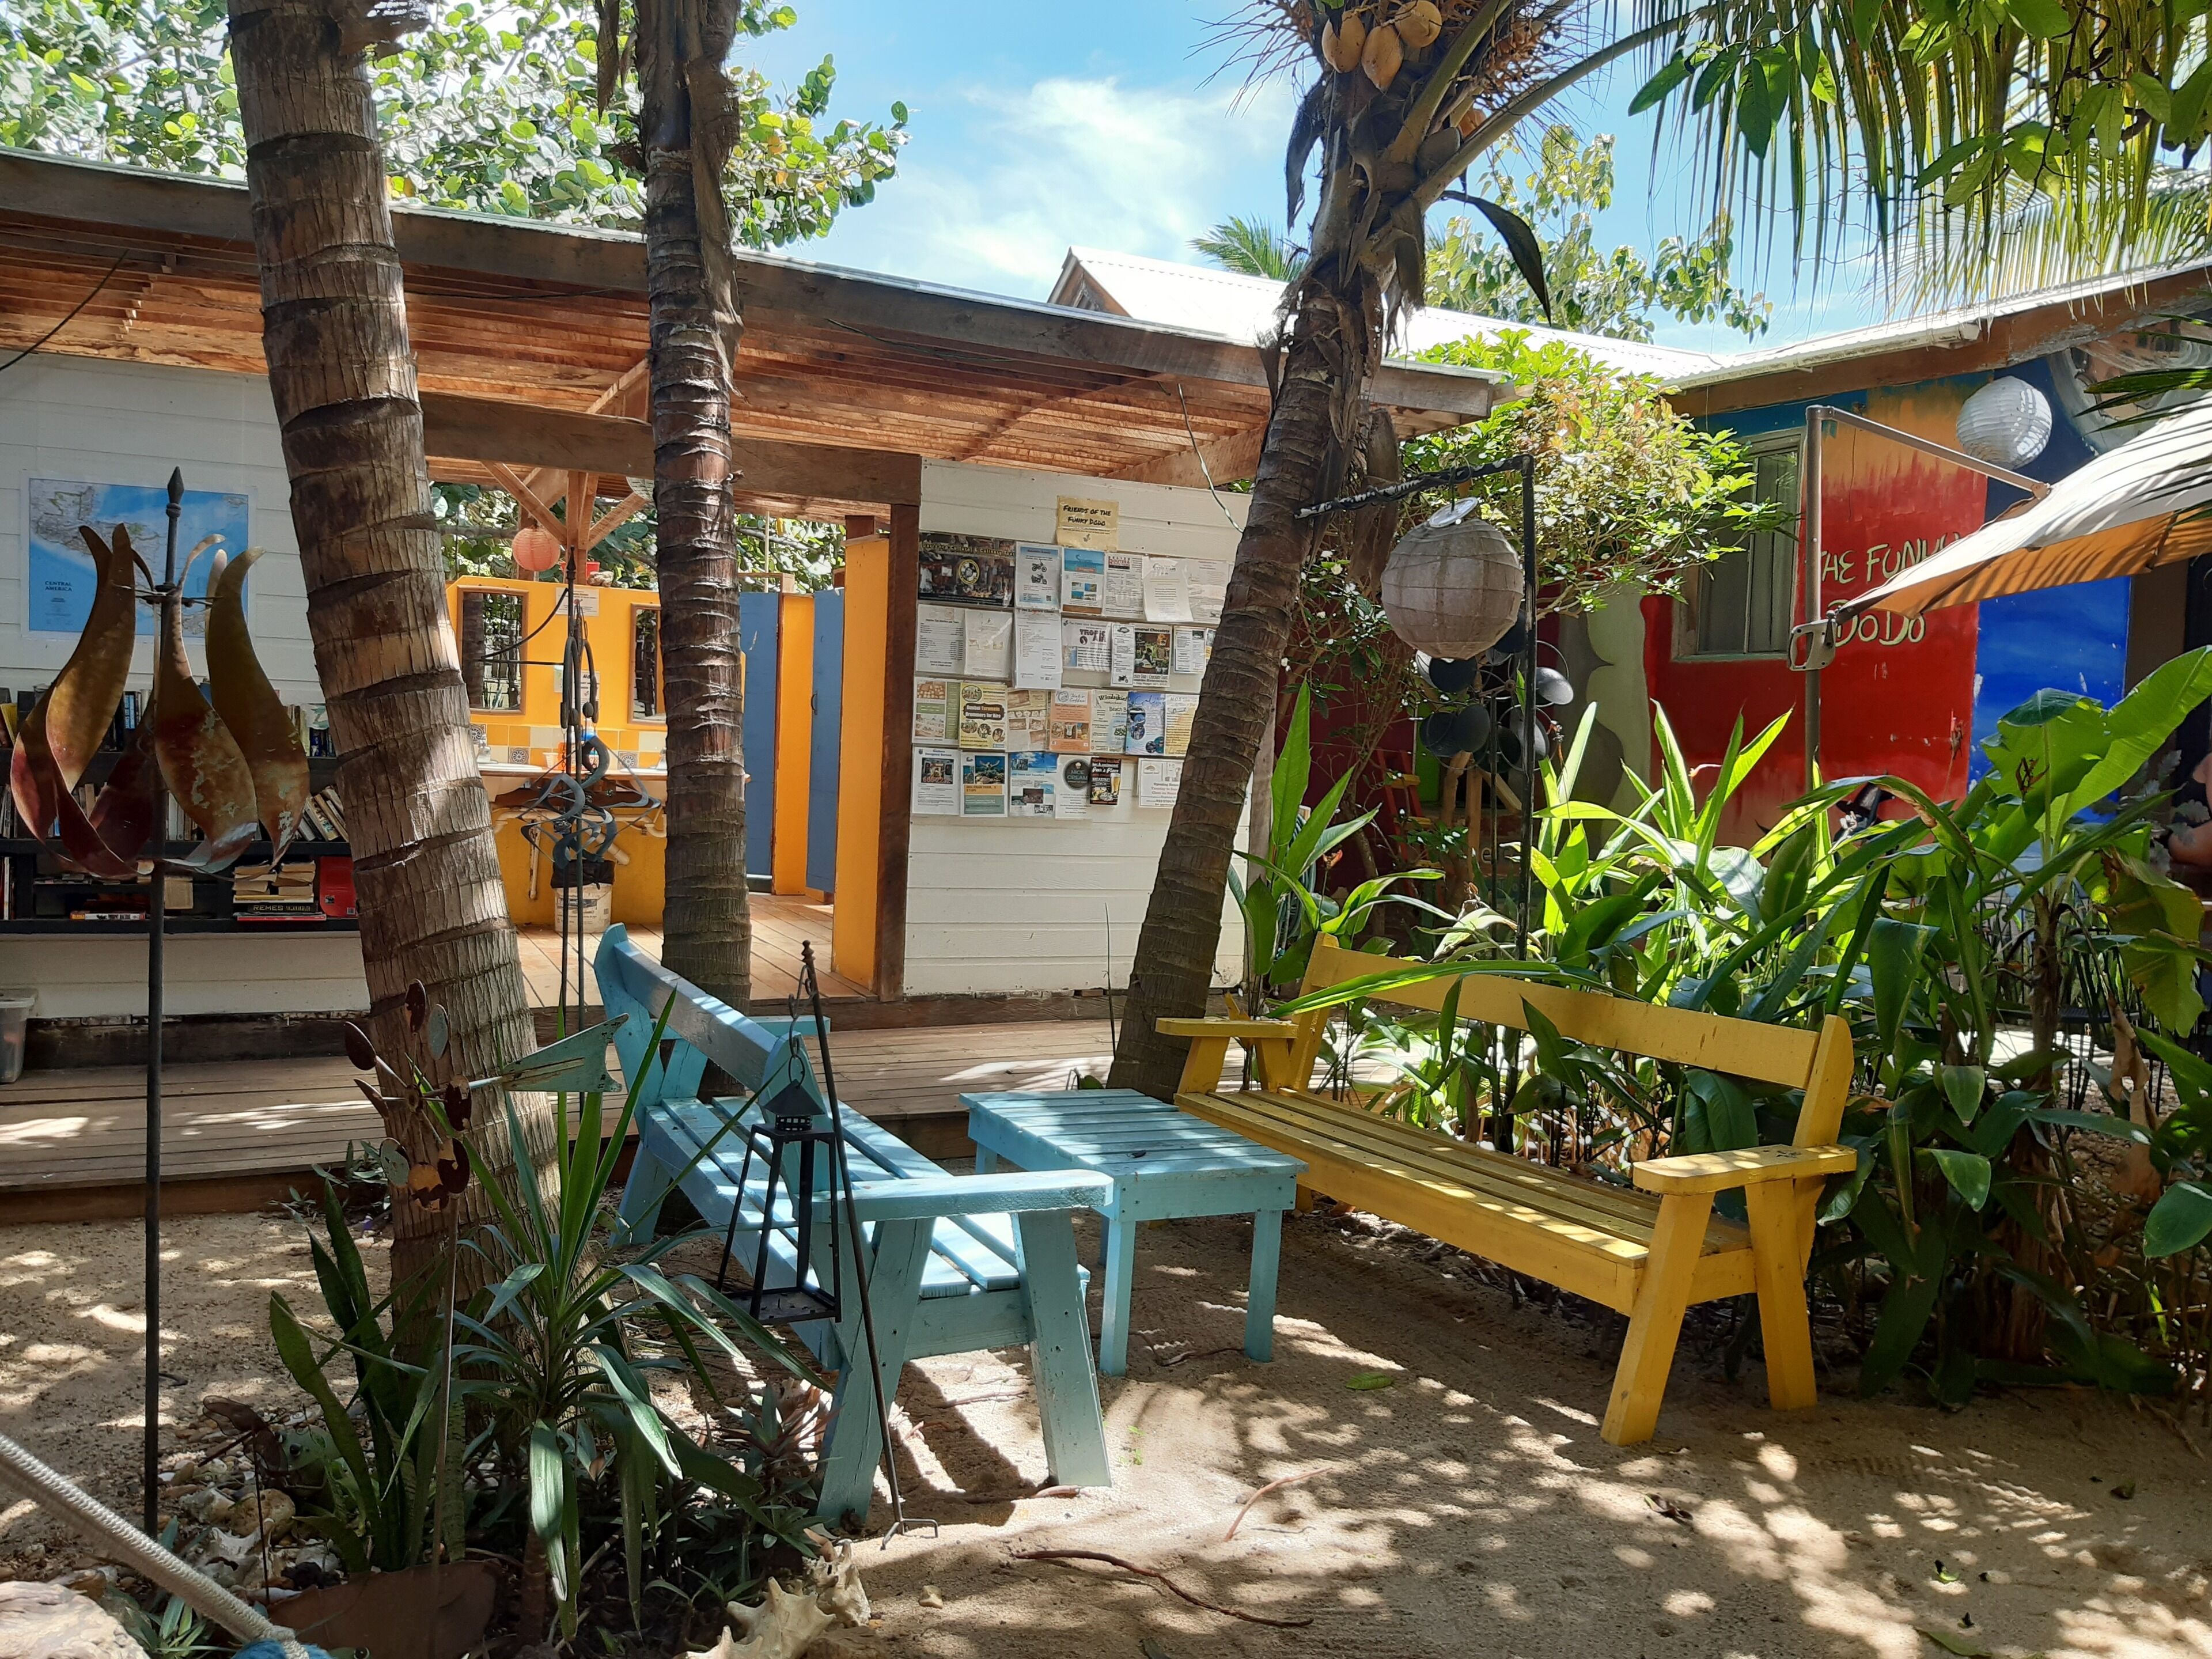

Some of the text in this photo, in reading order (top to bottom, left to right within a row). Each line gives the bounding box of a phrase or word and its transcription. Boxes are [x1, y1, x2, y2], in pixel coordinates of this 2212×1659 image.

[1063, 505, 1089, 514] FRIENDS
[1067, 516, 1106, 527] FUNKY DODO
[1821, 550, 1857, 584] HE
